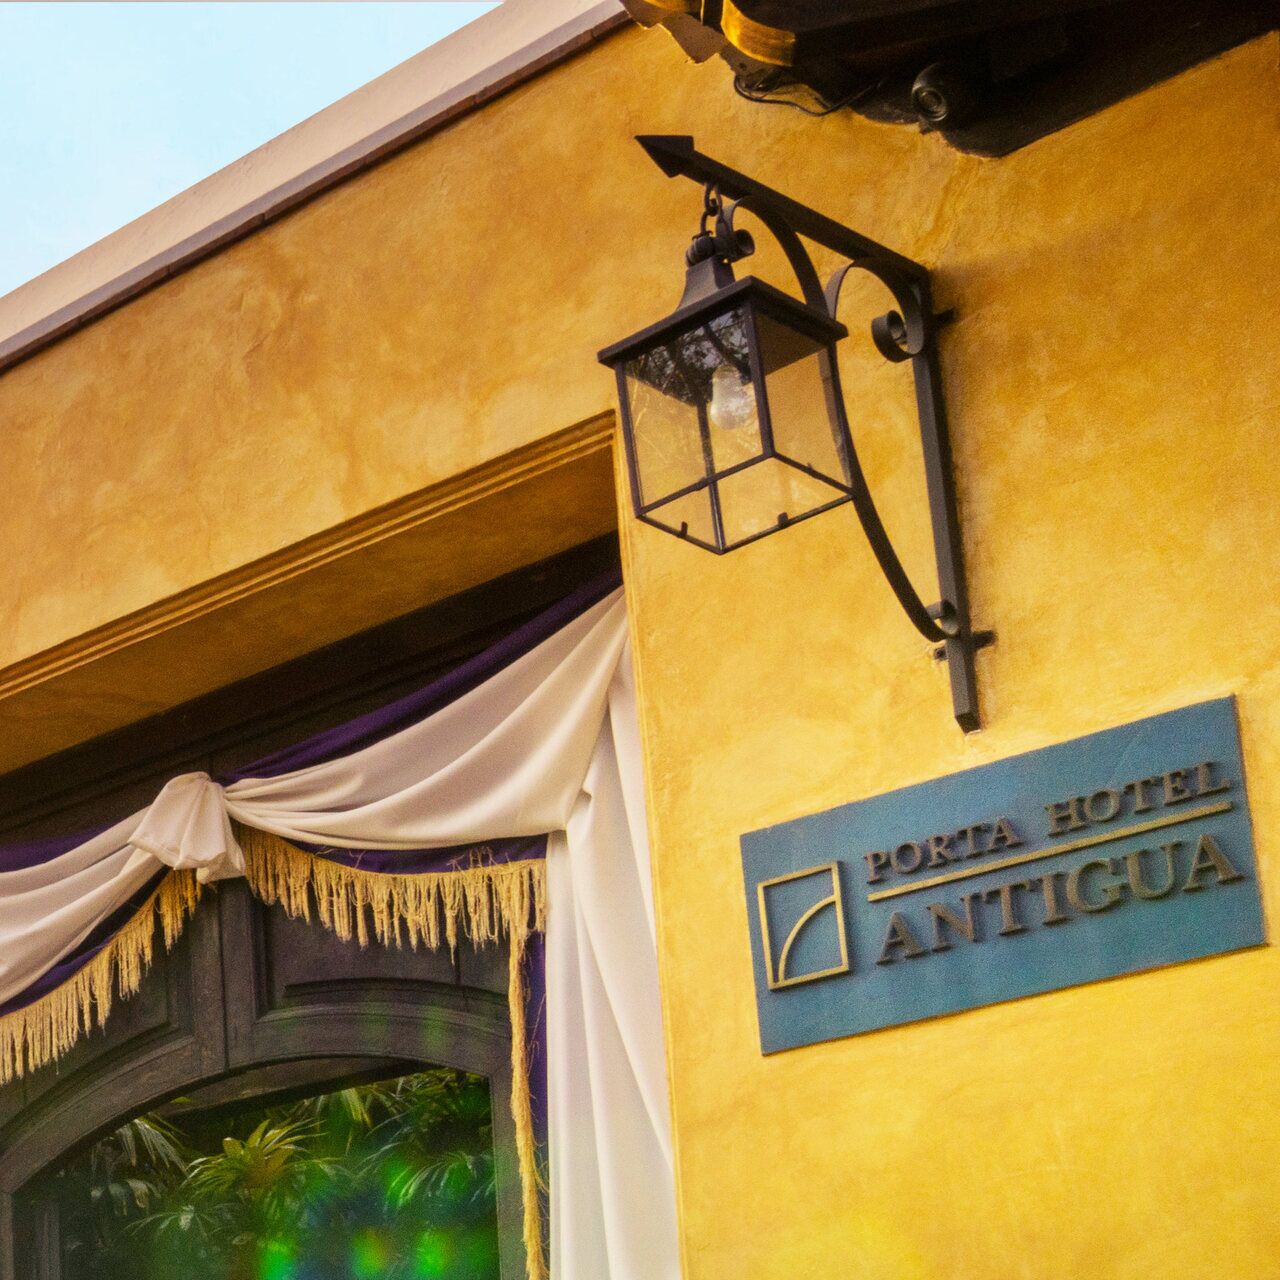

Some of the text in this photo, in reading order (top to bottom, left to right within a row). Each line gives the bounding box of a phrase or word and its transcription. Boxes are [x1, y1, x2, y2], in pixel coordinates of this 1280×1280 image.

[864, 762, 1233, 884] PORTA HOTEL
[875, 834, 1244, 966] ANTIGUA
